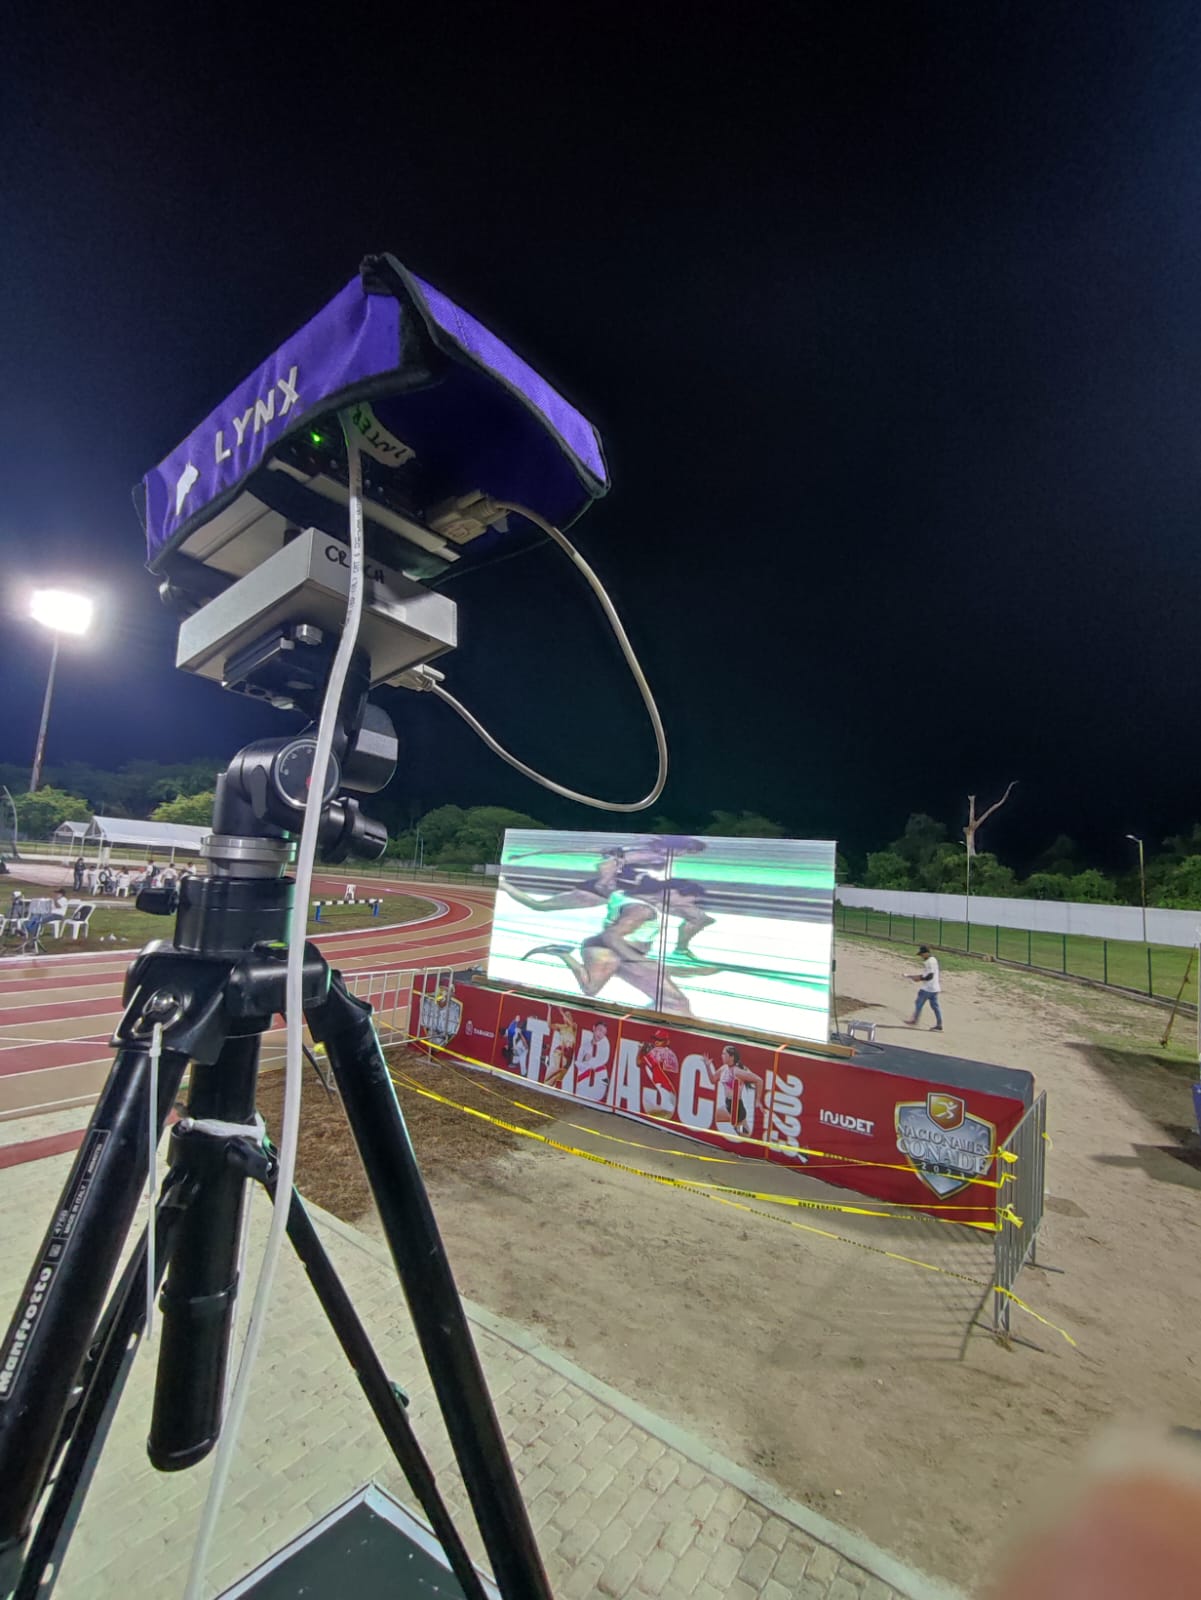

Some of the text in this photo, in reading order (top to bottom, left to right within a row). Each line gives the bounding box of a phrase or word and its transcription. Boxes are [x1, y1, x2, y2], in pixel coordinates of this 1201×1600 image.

[215, 366, 299, 464] LYNX
[325, 545, 384, 584] CRCH
[896, 1137, 989, 1175] CONADE
[897, 1124, 992, 1156] NACIONALES
[75, 1185, 86, 1204] ITALY
